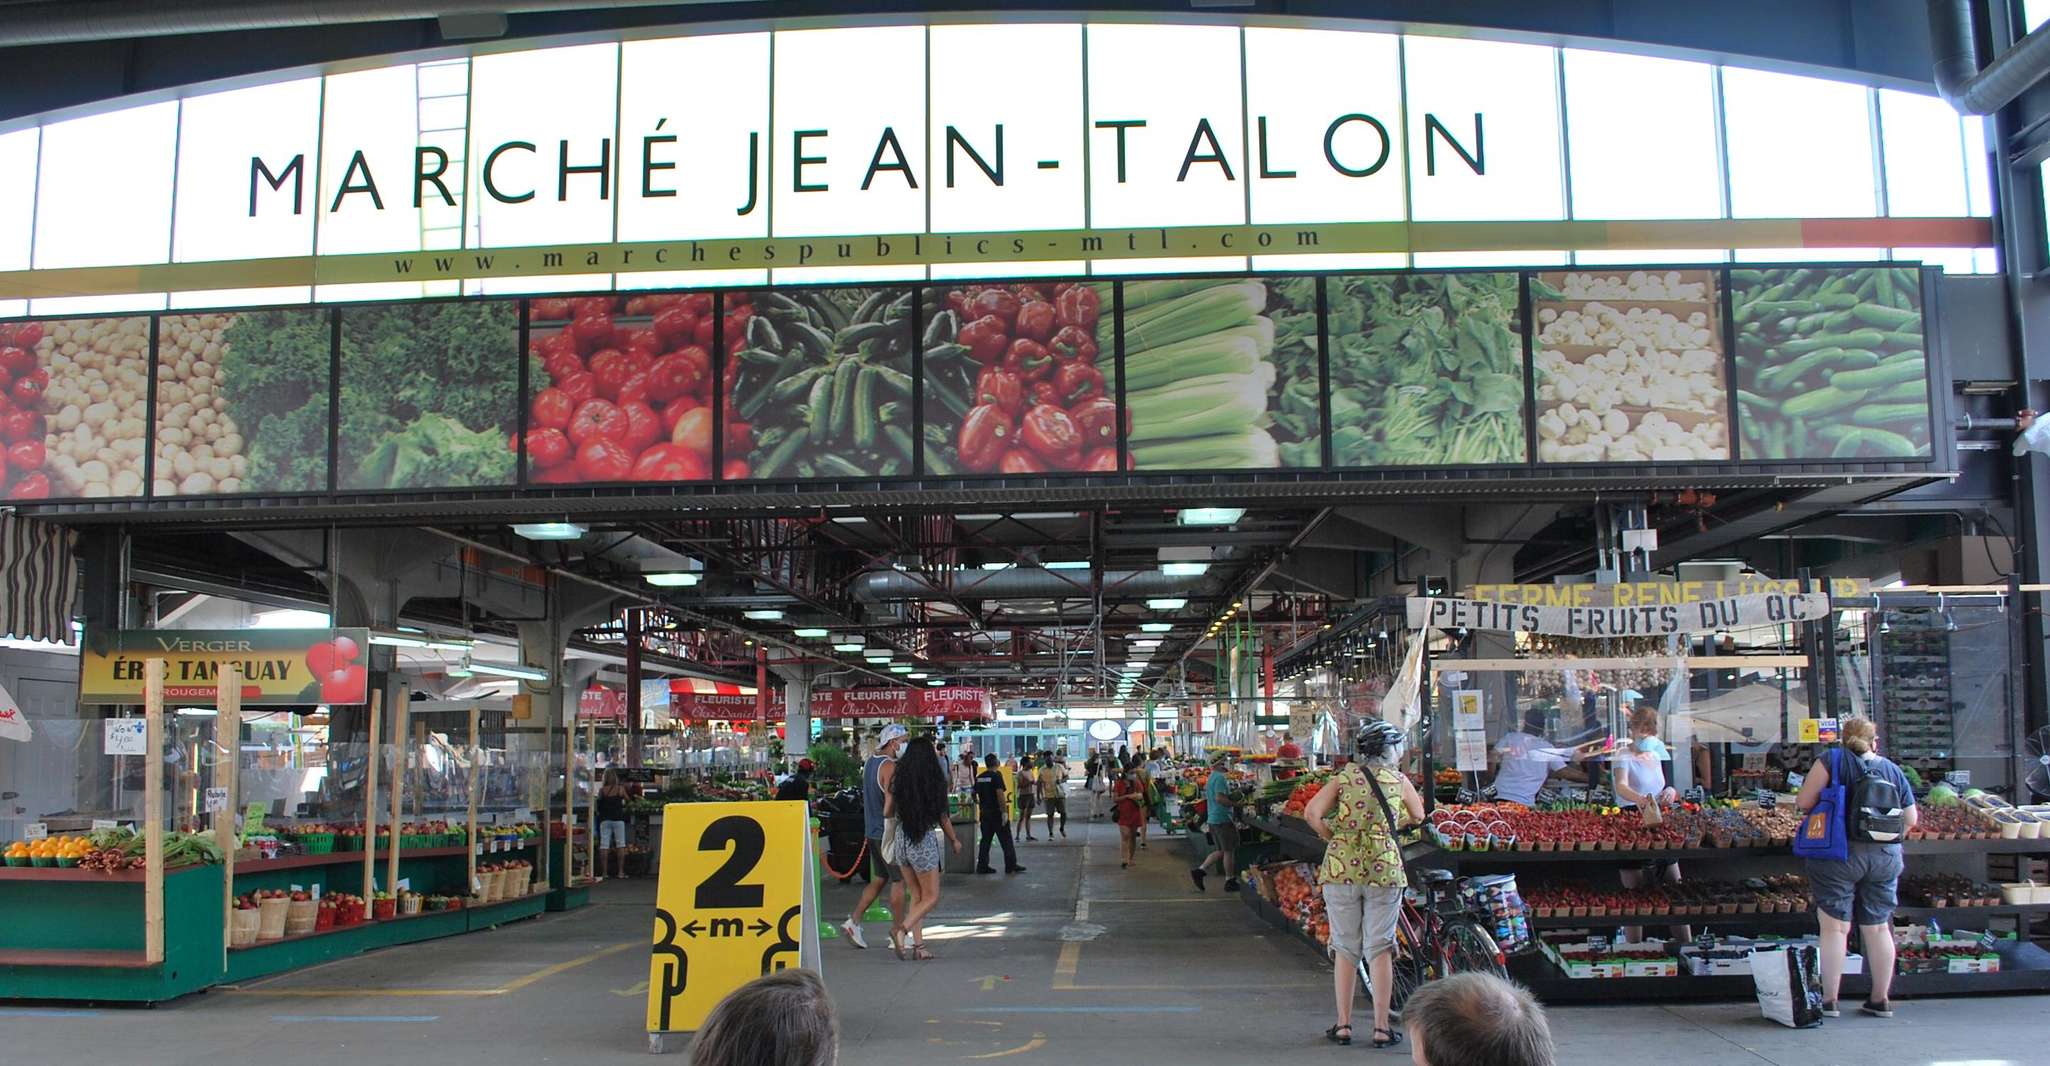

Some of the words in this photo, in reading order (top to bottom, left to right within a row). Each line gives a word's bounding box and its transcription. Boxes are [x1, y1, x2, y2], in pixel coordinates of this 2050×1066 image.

[249, 118, 678, 217] MARCHÉ
[736, 112, 1486, 216] JEAN-TALON
[394, 229, 1319, 274] www.marchespublics-mtl.com
[1430, 600, 1539, 632] PETITS
[1567, 606, 1678, 635] FRUITS
[1700, 599, 1738, 628] DU
[1766, 595, 1806, 621] QC
[156, 636, 254, 653] VERGER
[694, 695, 756, 705] FLEURISTE
[844, 690, 907, 701] FLEURISTE
[925, 690, 984, 702] FLEURISTE
[842, 702, 865, 715] Chez
[867, 702, 909, 715] Daniel
[693, 815, 766, 910] 2
[709, 917, 744, 938] m
